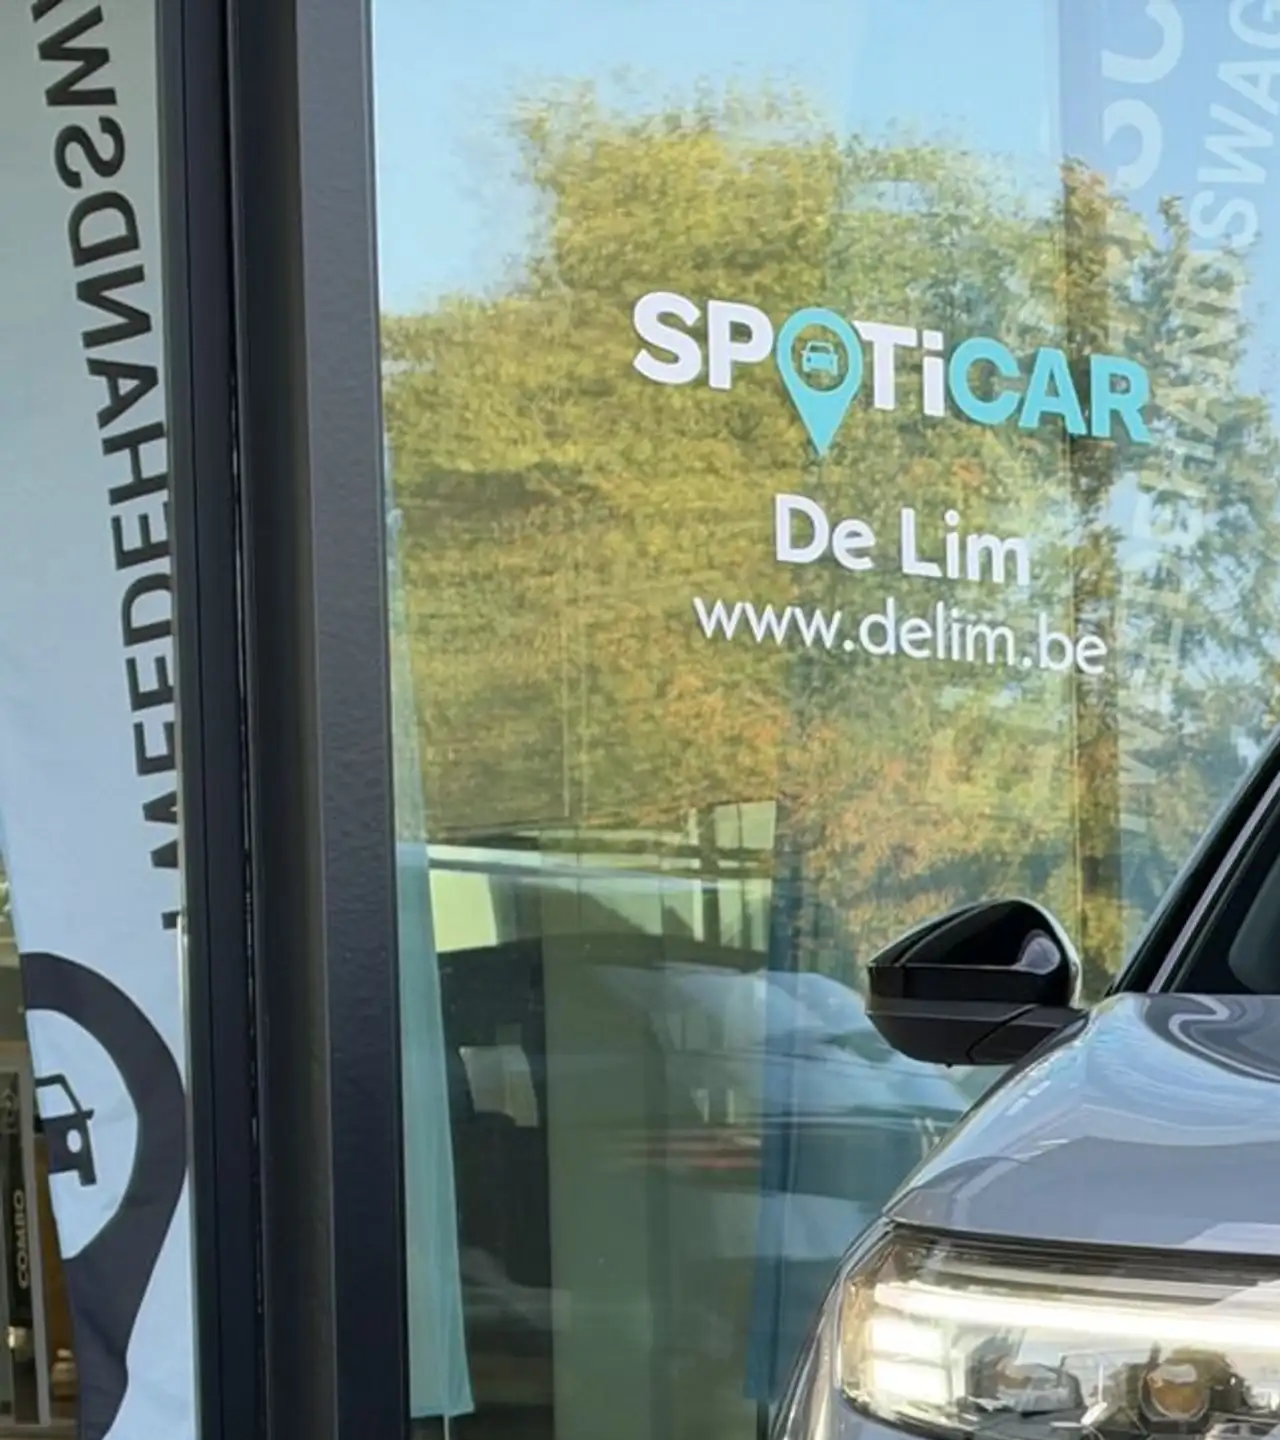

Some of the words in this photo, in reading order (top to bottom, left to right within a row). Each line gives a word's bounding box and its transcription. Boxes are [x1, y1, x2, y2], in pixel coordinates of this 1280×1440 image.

[774, 494, 876, 572] De
[901, 506, 1031, 586] Lim
[693, 597, 1108, 675] www.delim.be
[13, 1189, 31, 1290] COMBO
